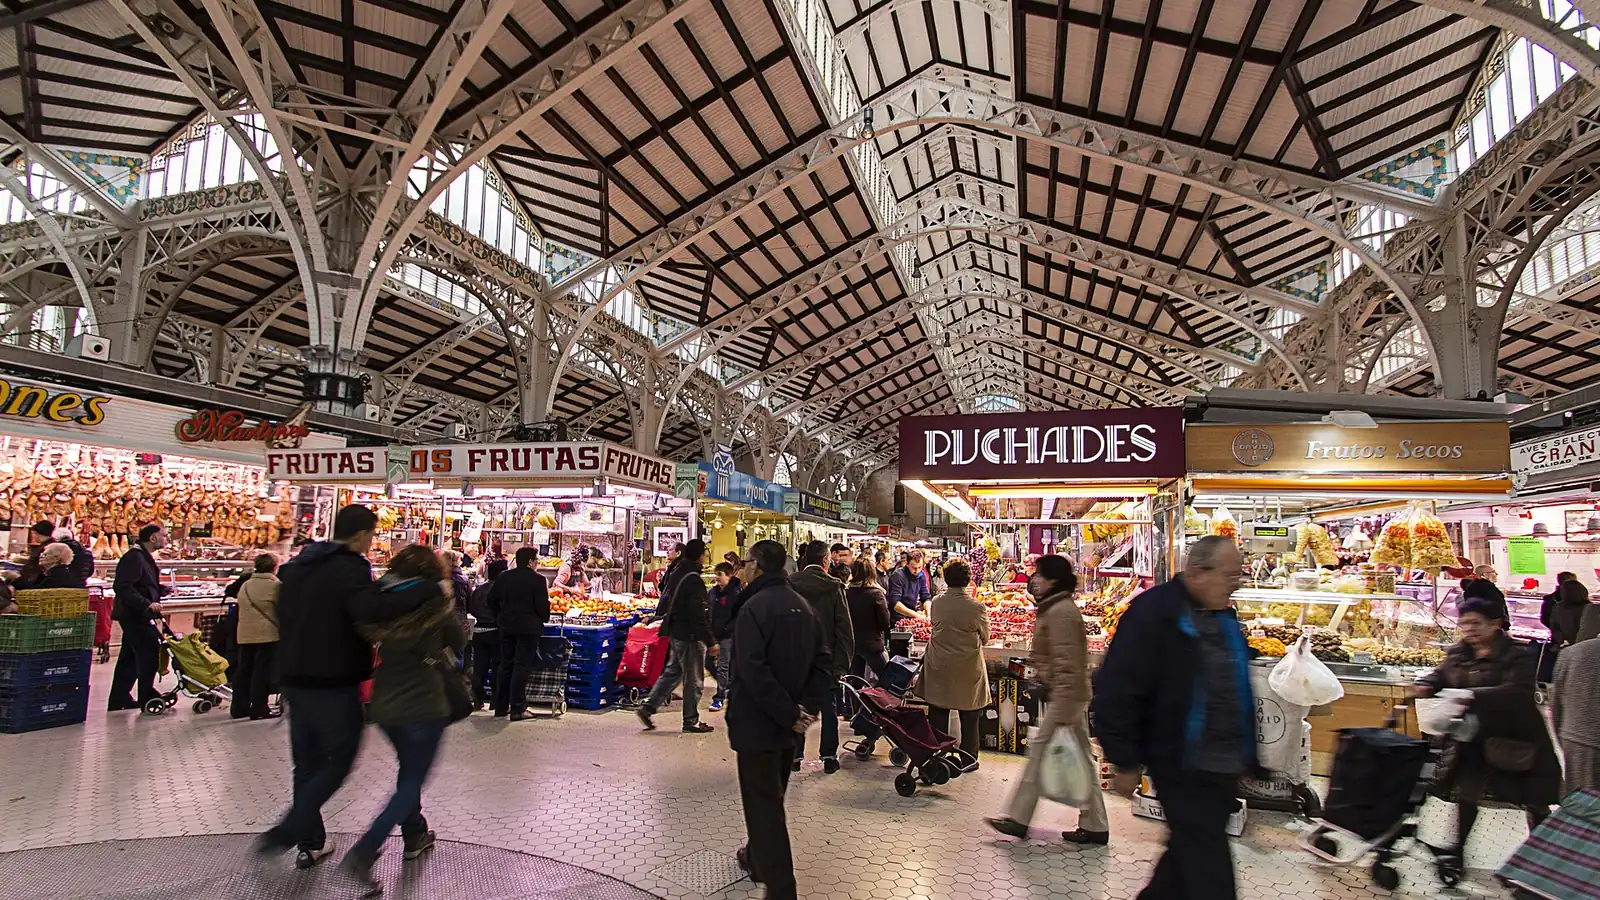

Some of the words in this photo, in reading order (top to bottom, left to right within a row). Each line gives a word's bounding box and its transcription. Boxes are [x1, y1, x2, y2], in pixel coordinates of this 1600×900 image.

[924, 424, 1157, 466] PUCHADES
[1304, 439, 1385, 460] Frutos
[1397, 439, 1463, 459] Secos
[1520, 442, 1548, 455] AVES
[1530, 440, 1595, 464] GRAN
[268, 451, 375, 475] FRUTAS
[467, 446, 600, 472] FRUTAS
[1534, 459, 1572, 469] CALIDAD
[1256, 699, 1266, 741] DAVID
